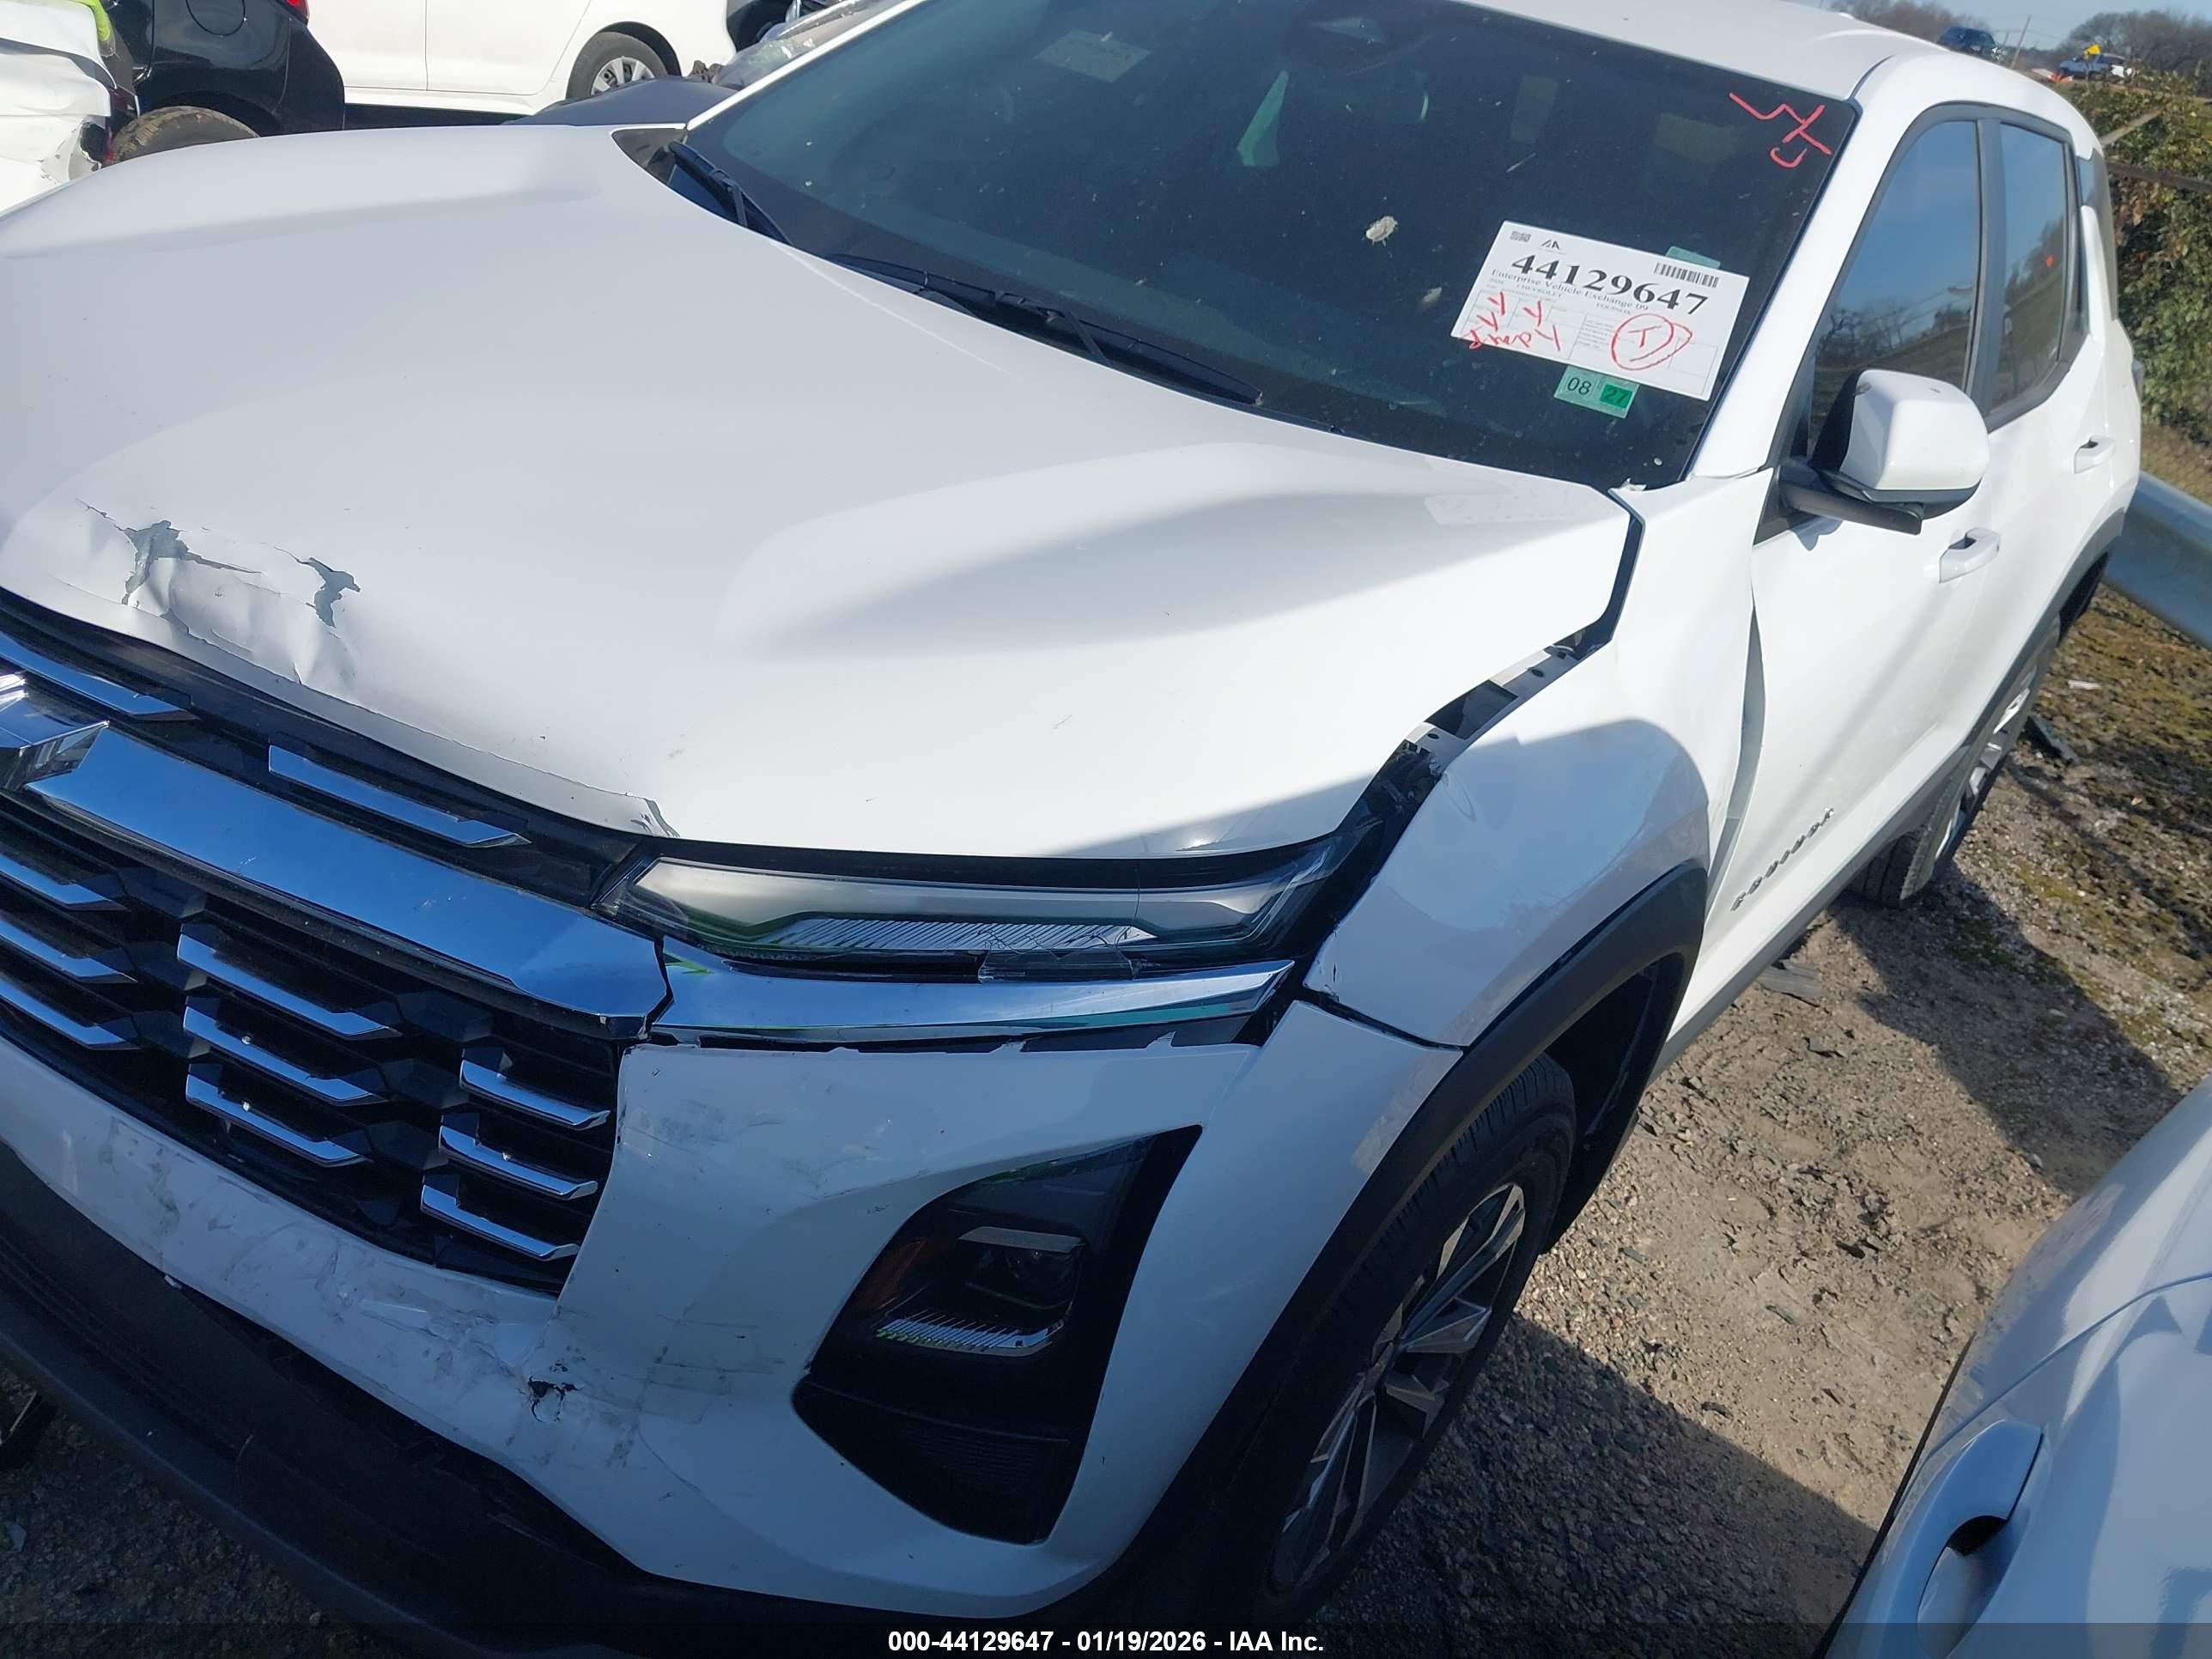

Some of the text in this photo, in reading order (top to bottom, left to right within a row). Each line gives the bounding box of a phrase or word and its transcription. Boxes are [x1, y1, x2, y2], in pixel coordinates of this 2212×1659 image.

[1492, 269, 1541, 286] Enterprise
[1545, 281, 1582, 296] Vehicle
[1584, 290, 1632, 308] Exchange
[1511, 254, 1708, 314] 44129647
[1567, 377, 1591, 395] 08
[1604, 387, 1628, 404] 27
